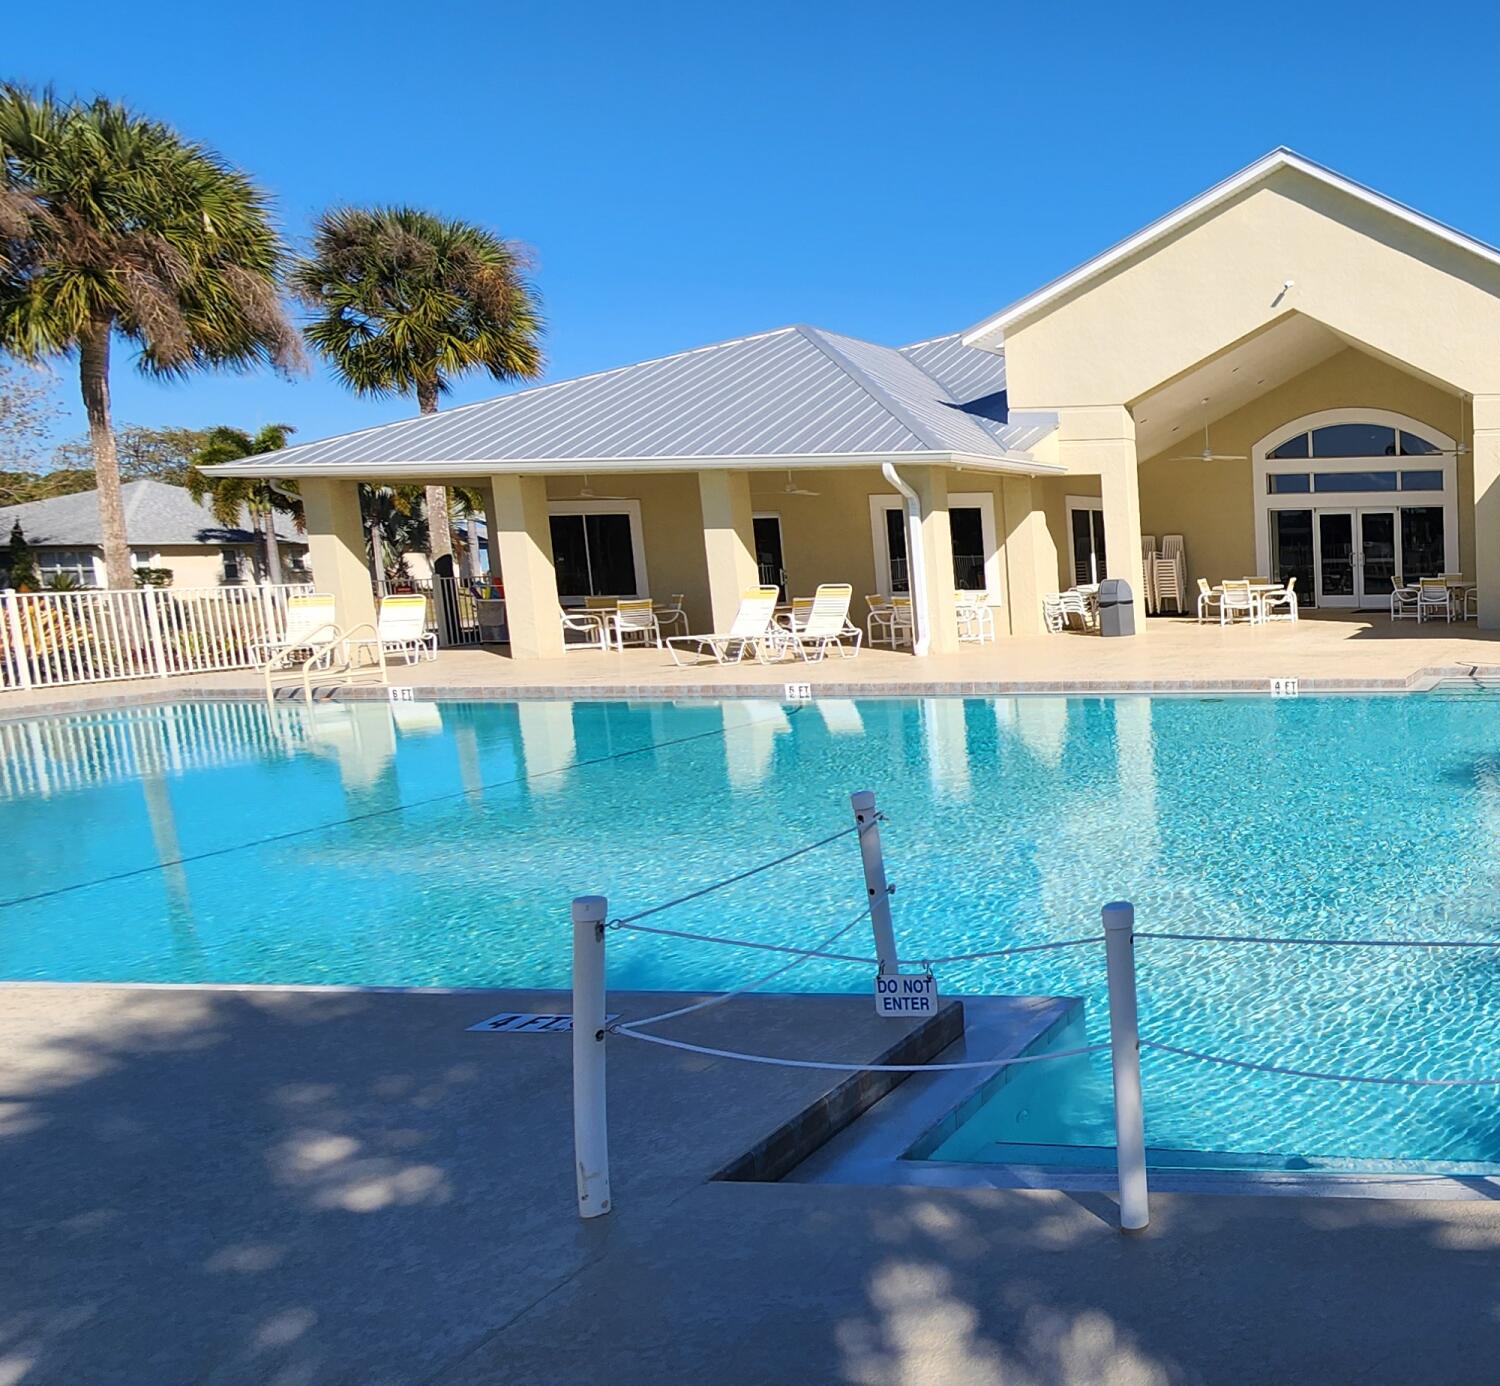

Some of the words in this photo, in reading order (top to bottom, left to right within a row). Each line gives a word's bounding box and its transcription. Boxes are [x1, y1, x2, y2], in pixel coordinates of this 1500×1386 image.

[877, 979, 898, 993] DO
[903, 979, 932, 993] NOT
[883, 997, 930, 1011] ENTER
